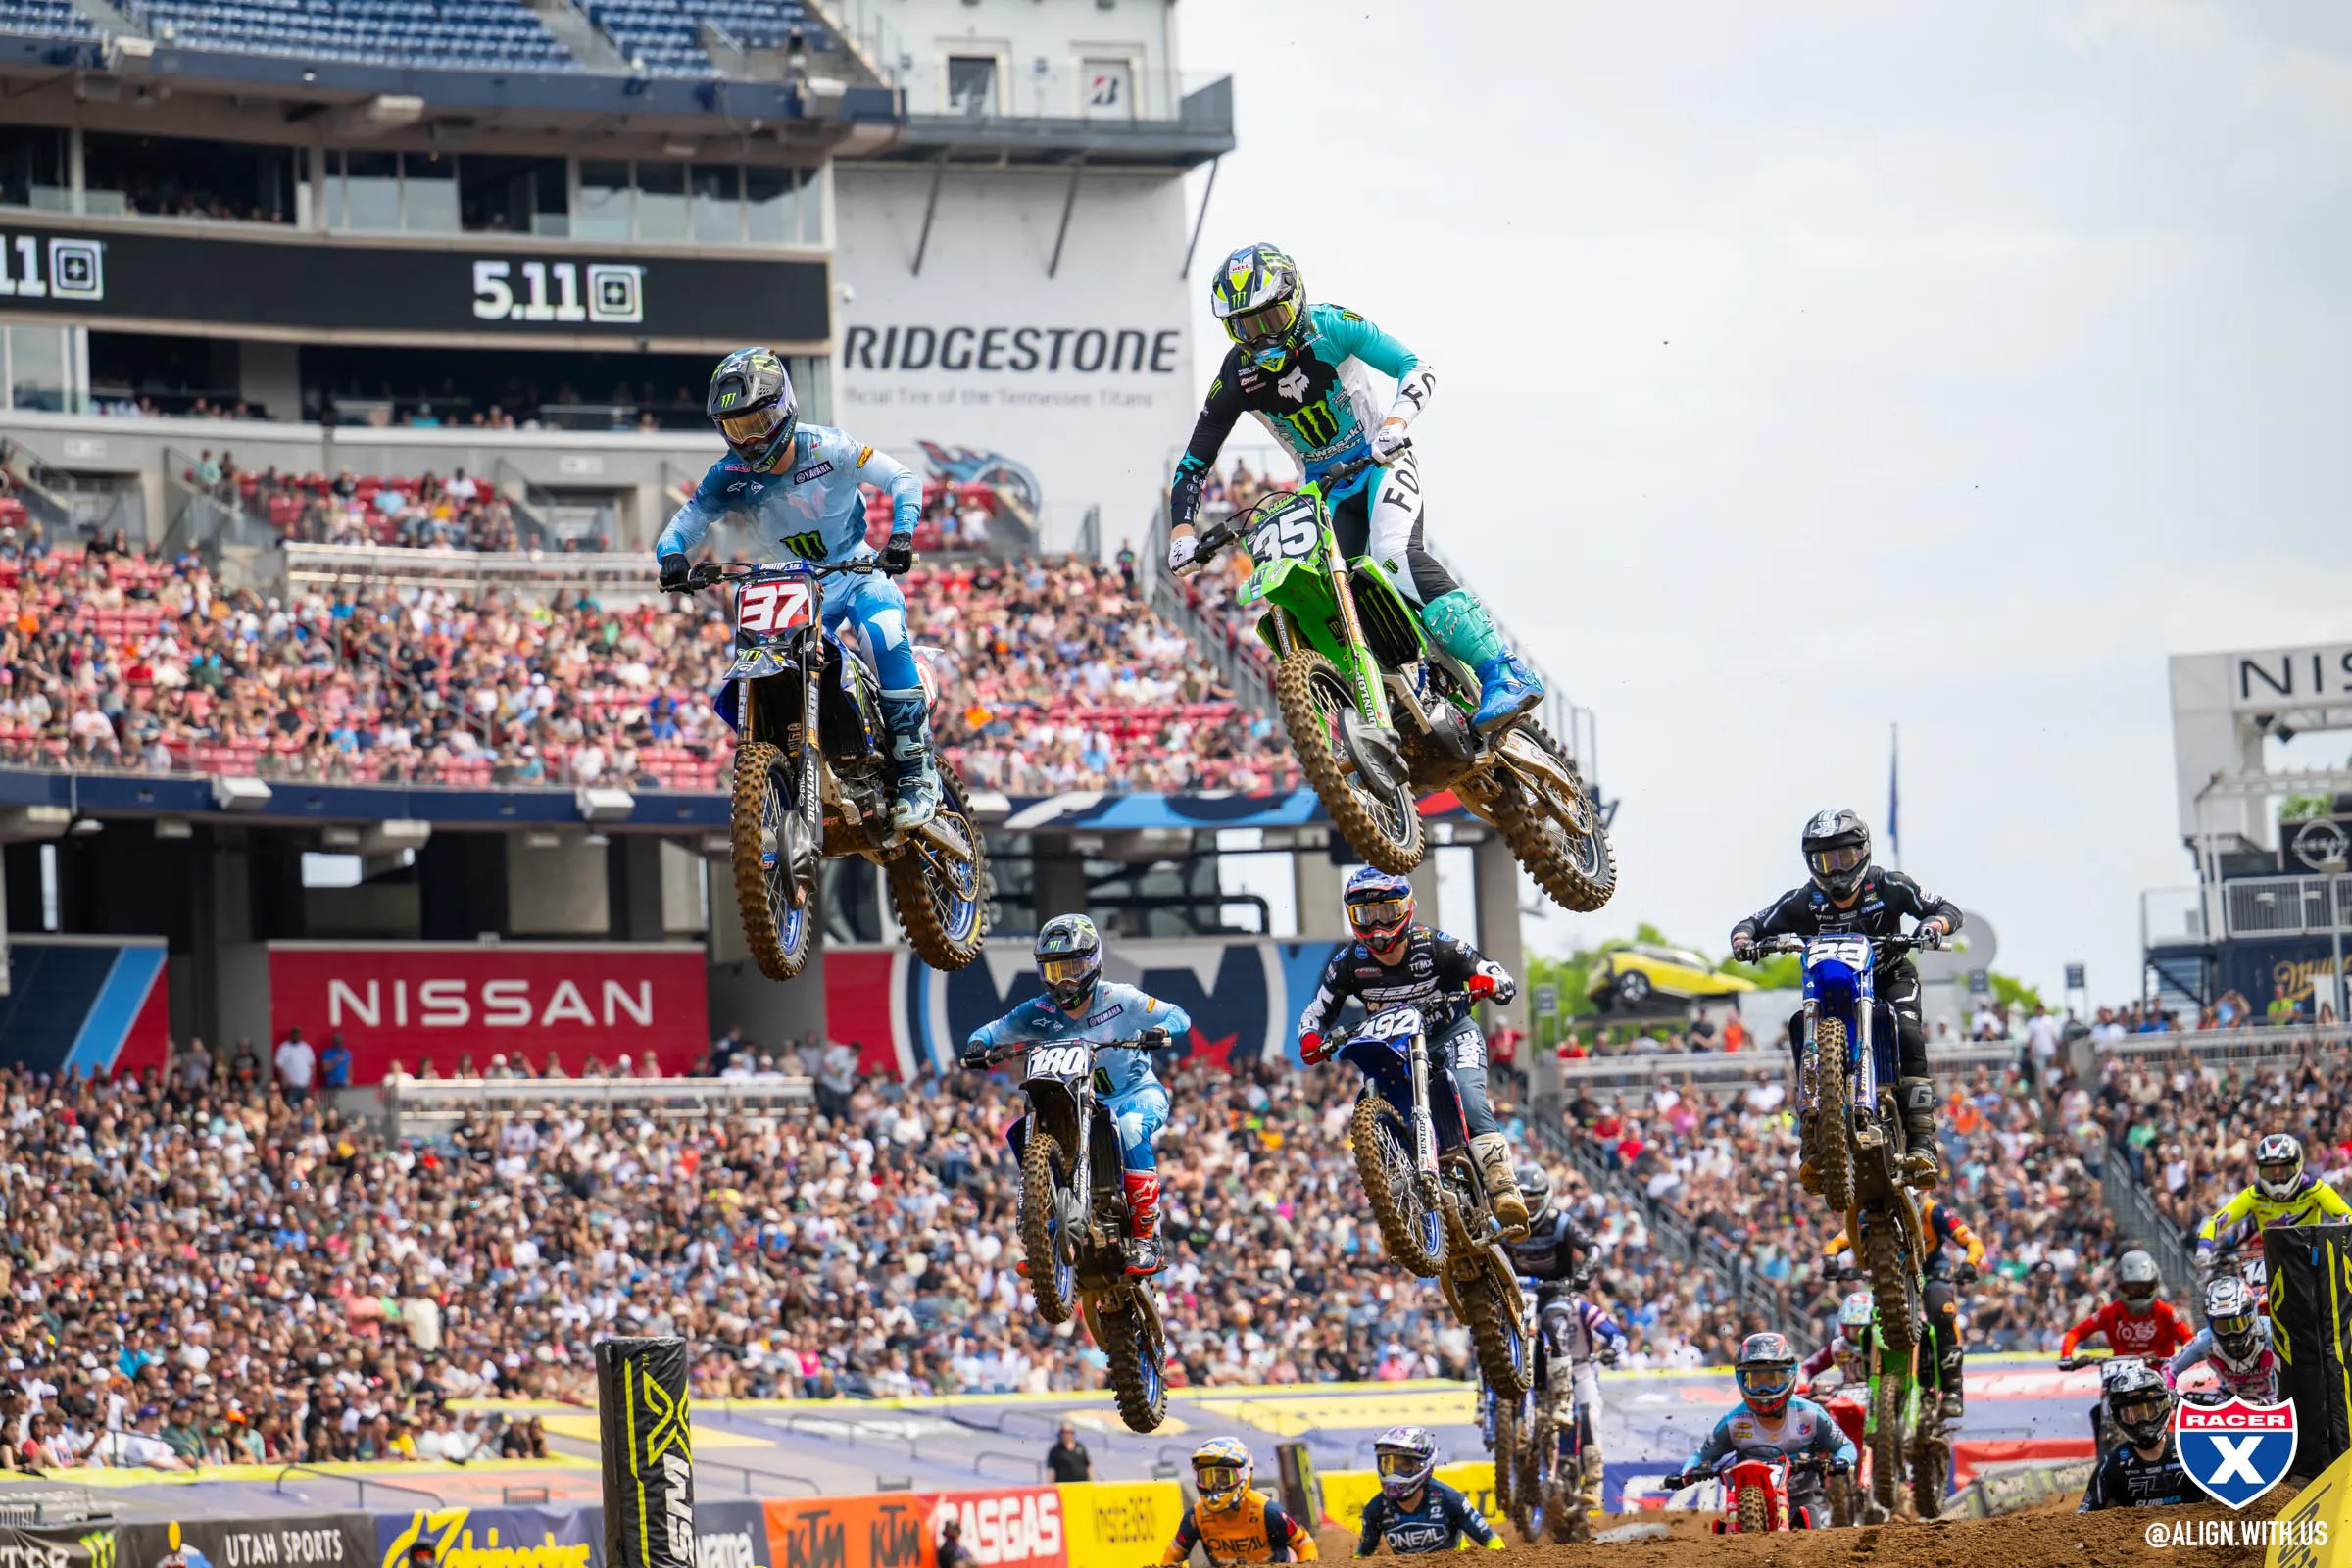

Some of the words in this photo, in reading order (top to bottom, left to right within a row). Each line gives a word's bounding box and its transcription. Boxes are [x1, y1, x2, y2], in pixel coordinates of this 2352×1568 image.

[1232, 263, 1250, 273] BELL
[472, 259, 586, 322] 5.11
[844, 325, 1181, 374] RIDGESTONE
[1401, 365, 1437, 411] FO
[804, 462, 832, 480] YAMAHA
[740, 583, 808, 632] 37
[2240, 653, 2352, 700] NI
[807, 760, 816, 824] DUNLOP
[328, 979, 654, 1027] NISSAN
[1095, 1005, 1122, 1024] YAMAHA
[1359, 1008, 1412, 1040] 192
[1031, 1046, 1085, 1075] 180
[1419, 1118, 1428, 1155] DUNLOP
[225, 1533, 278, 1567] UTAH
[283, 1529, 343, 1563] SPORTS
[787, 1509, 846, 1568] KTM
[870, 1505, 920, 1568] KTM
[1207, 1535, 1265, 1553] ONEAL
[1387, 1527, 1445, 1547] ONEAL
